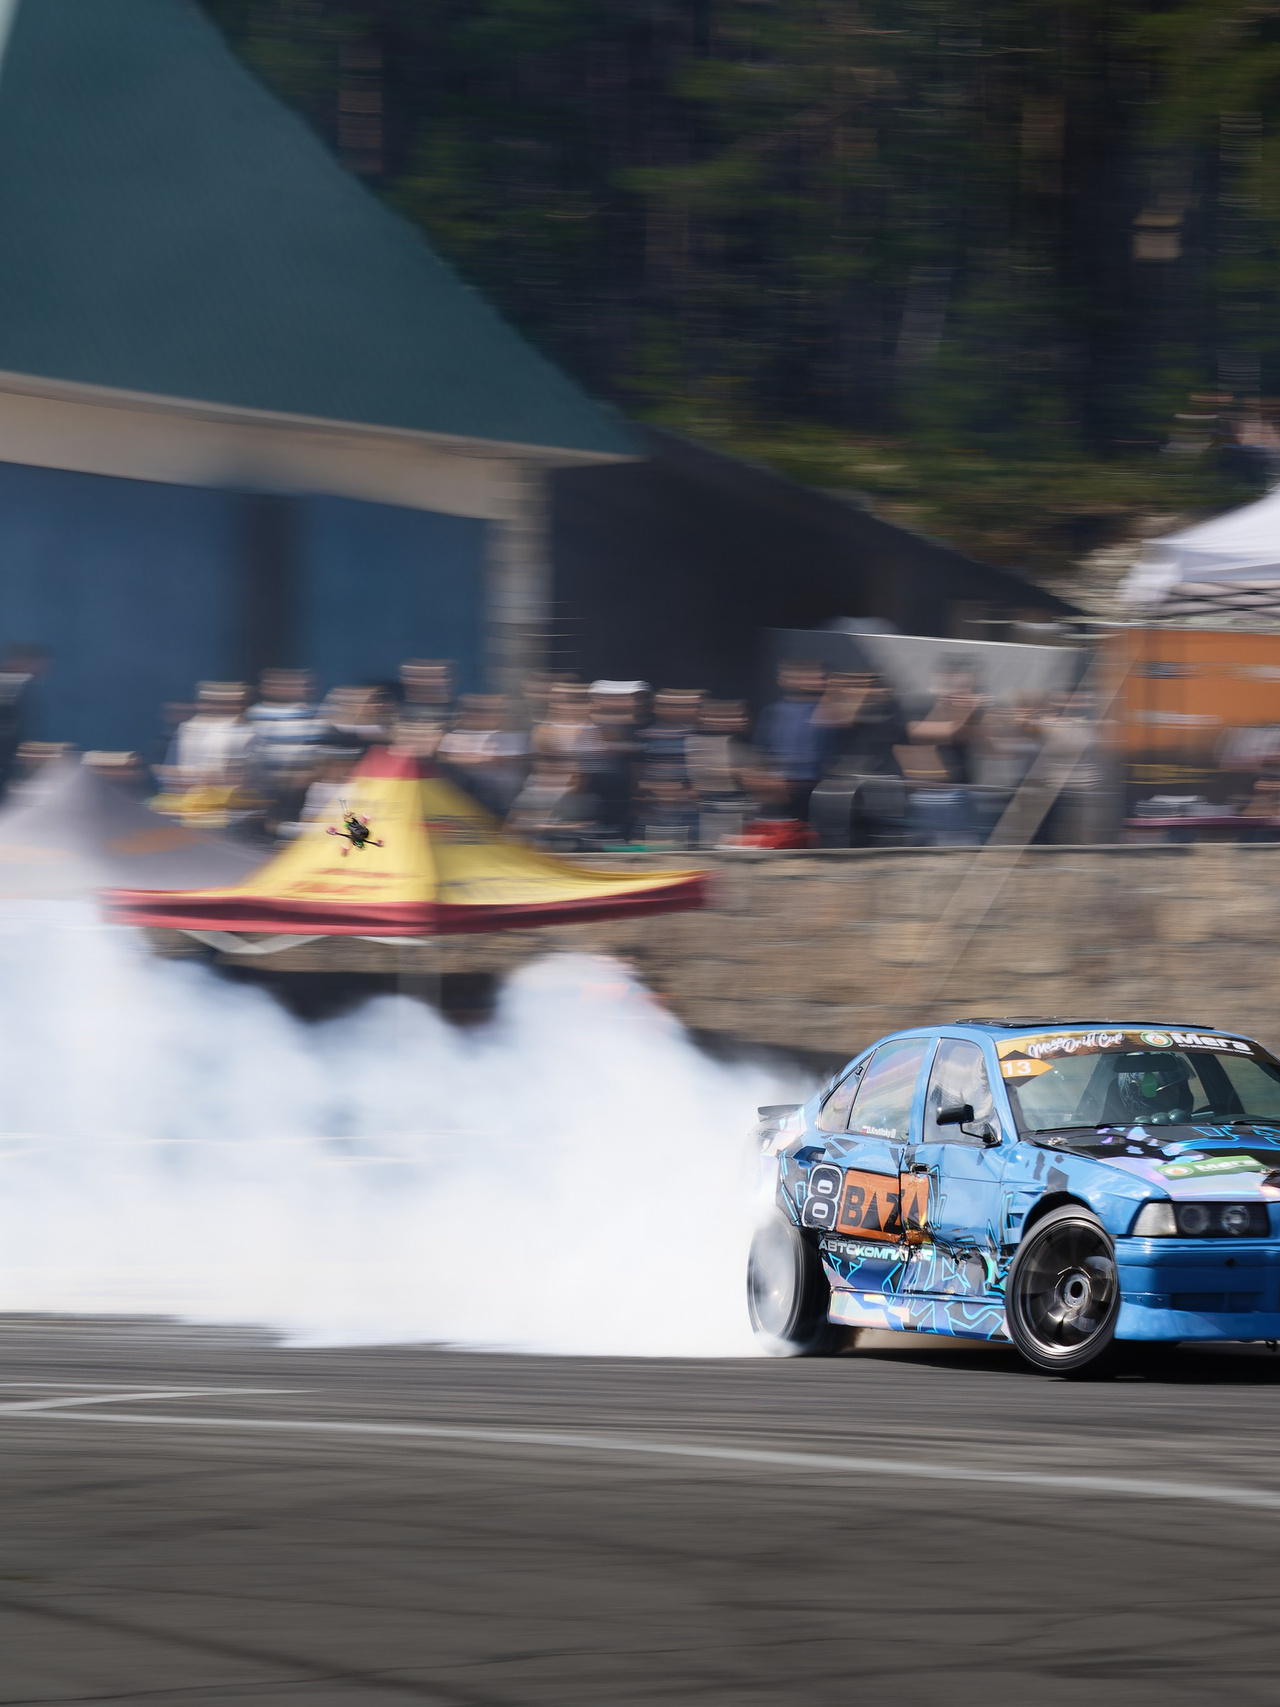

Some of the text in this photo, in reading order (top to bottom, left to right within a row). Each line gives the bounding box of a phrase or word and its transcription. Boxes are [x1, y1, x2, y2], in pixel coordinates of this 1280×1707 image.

[1062, 1033, 1099, 1052] Drift
[1098, 1032, 1125, 1048] Cup
[1002, 1060, 1032, 1076] 13
[801, 1163, 843, 1232] 8
[841, 1184, 922, 1234] BAZA
